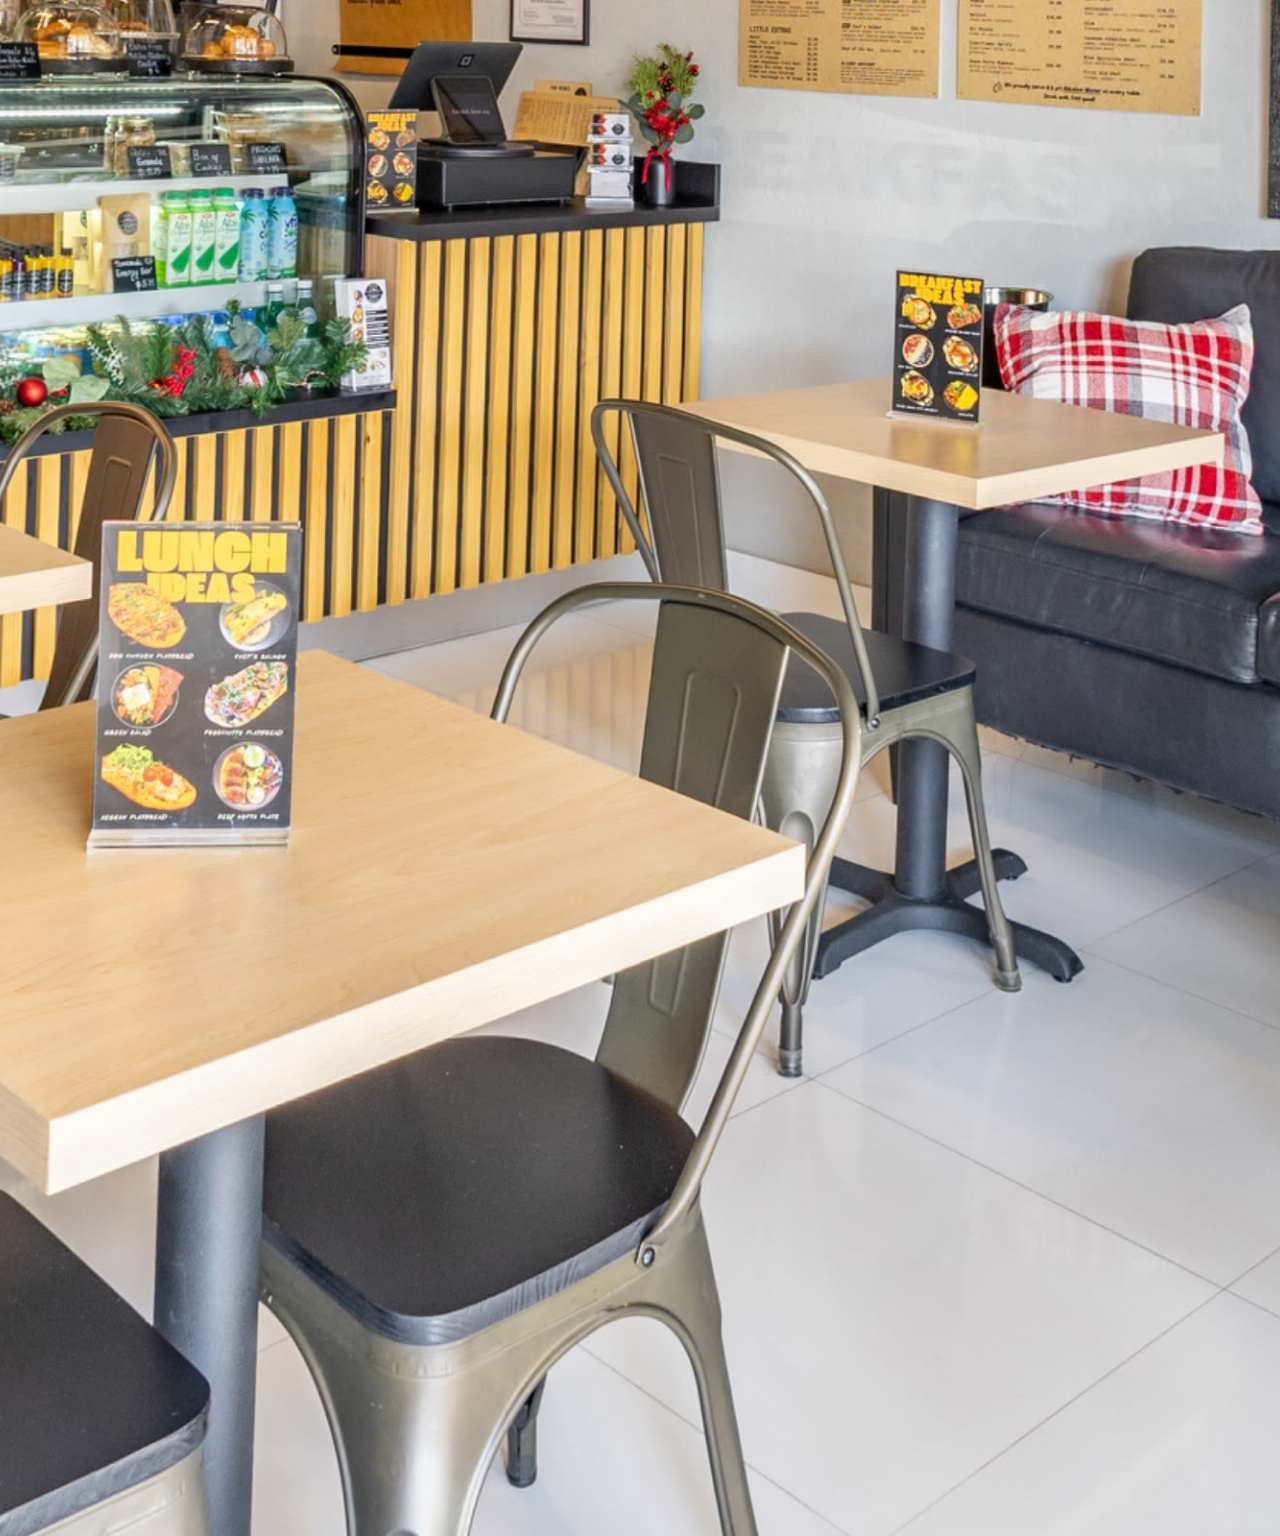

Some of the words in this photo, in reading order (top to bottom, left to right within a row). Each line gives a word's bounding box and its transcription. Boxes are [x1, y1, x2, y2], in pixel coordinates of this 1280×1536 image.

[748, 25, 769, 34] LITTLE
[117, 530, 288, 573] LUNCH
[147, 572, 256, 604] IDEAS
